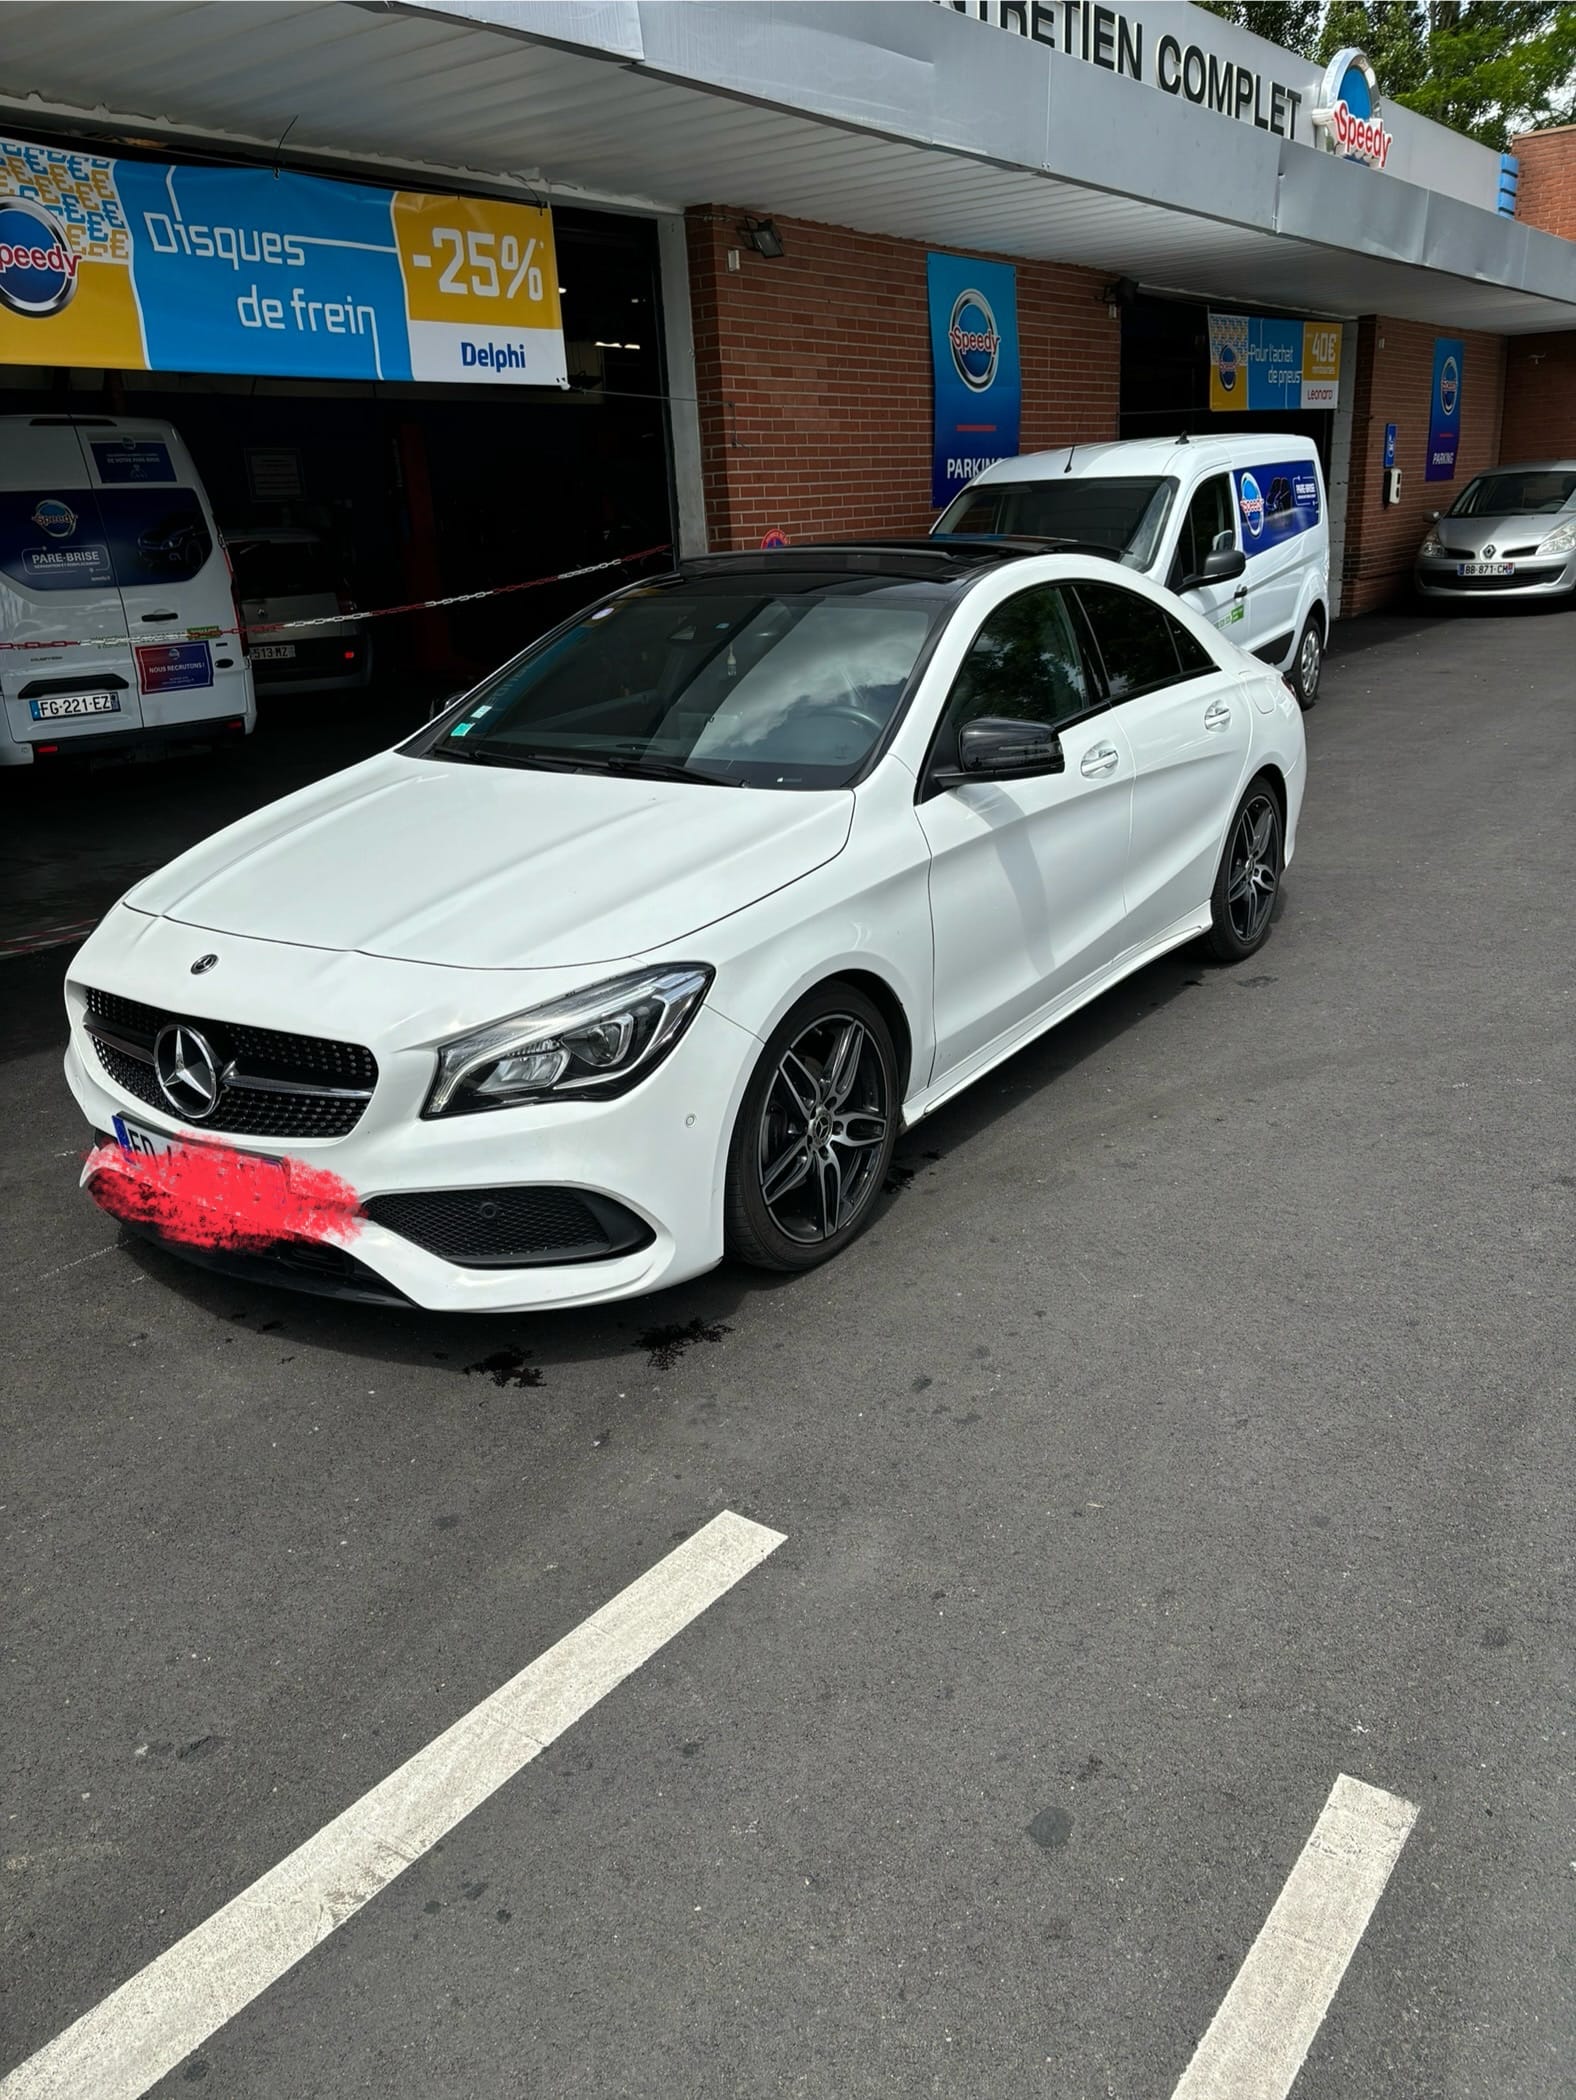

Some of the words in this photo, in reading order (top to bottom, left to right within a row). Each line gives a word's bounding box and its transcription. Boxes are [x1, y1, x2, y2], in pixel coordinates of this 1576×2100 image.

[1156, 34, 1301, 140] COMPLET
[1334, 102, 1392, 168] Speedy
[143, 210, 306, 271] Disques
[0, 243, 82, 279] peedy
[237, 284, 286, 330] de
[291, 288, 376, 335] frein
[461, 341, 526, 373] Delphi
[949, 327, 1000, 357] Speedy
[1311, 332, 1337, 363] 40€
[1268, 365, 1278, 384] de
[947, 458, 1003, 479] PARKI
[1432, 452, 1454, 465] PARKING
[32, 513, 78, 527] Speedy
[32, 551, 100, 564] PARE-BRISE
